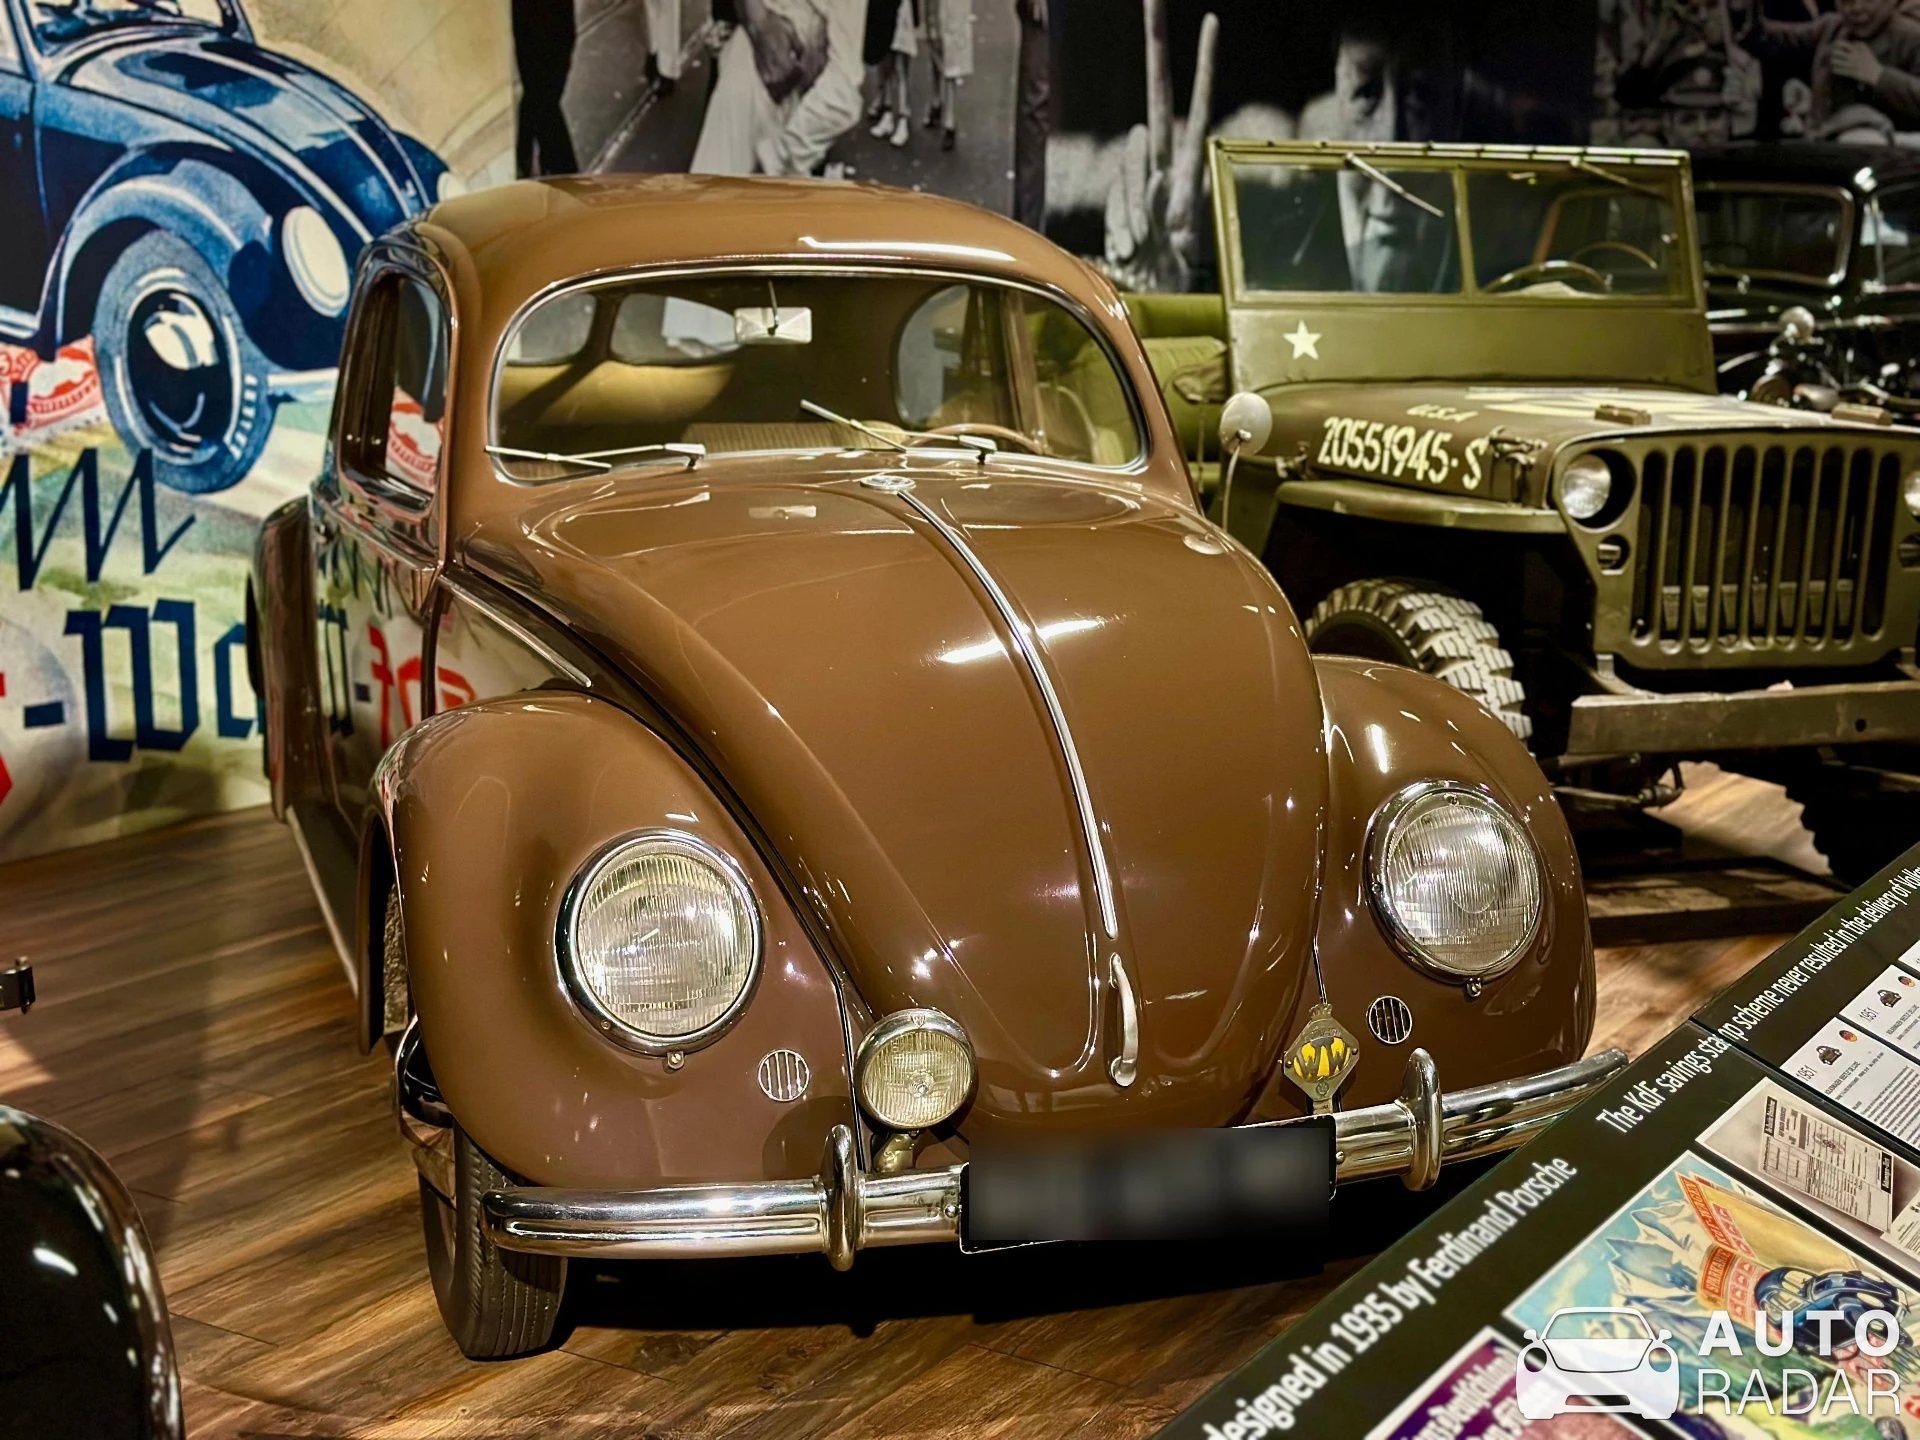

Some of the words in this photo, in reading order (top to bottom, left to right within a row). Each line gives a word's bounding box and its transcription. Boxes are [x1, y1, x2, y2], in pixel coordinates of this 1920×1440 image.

[1888, 879, 1912, 898] of
[1854, 890, 1908, 923] delivery
[1828, 928, 1858, 944] in
[1840, 917, 1873, 937] the
[1798, 931, 1849, 974] resulted
[1770, 965, 1811, 997] never
[1731, 991, 1785, 1030] scheme
[1655, 1050, 1713, 1094] savings
[1622, 1080, 1666, 1113] KdF
[1595, 1105, 1644, 1134] The
[1494, 1158, 1578, 1216] Porsche
[1407, 1199, 1518, 1288] Ferdinand
[1378, 1271, 1437, 1311] by
[1329, 1292, 1406, 1355] 1935
[1301, 1342, 1353, 1375] in
